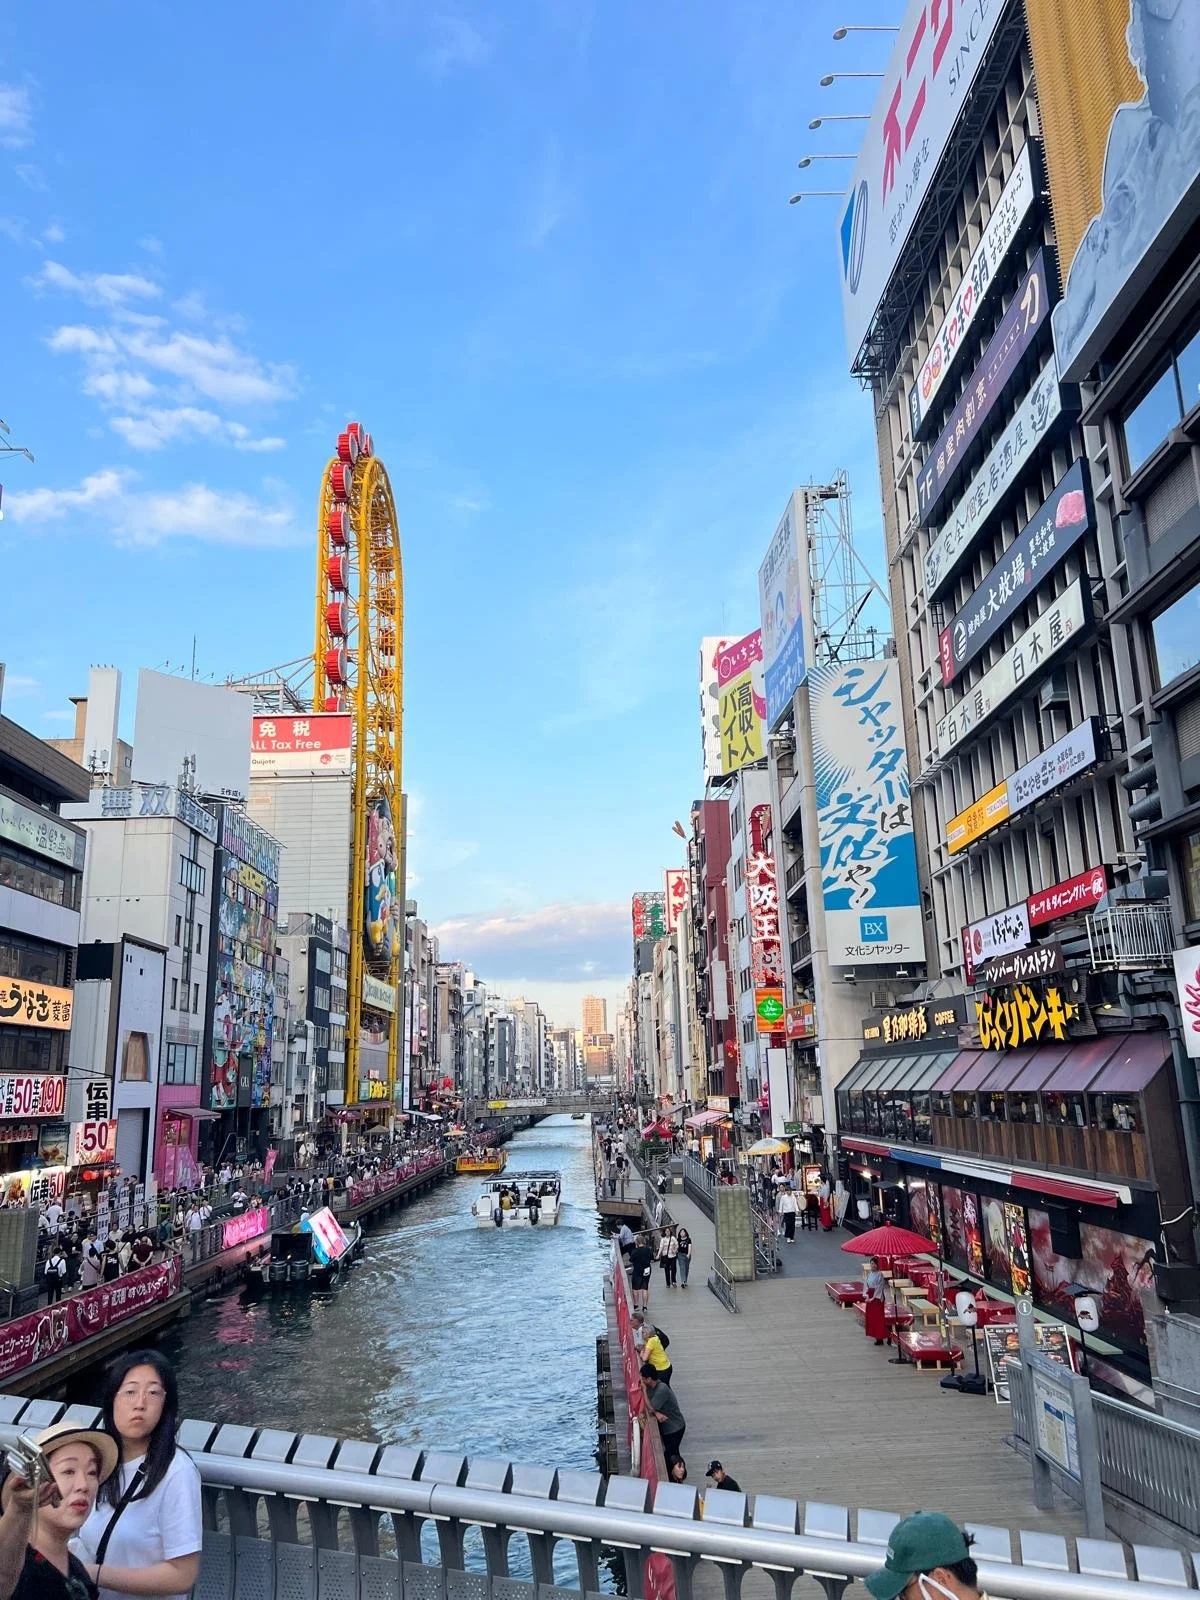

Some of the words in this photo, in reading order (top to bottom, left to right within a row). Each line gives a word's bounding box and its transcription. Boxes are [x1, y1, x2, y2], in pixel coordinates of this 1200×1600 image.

[988, 164, 1024, 248] しゃぶしゃぶ
[919, 477, 933, 509] 7F
[944, 420, 1028, 562] 完全個室居酒屋
[987, 553, 1025, 621] 大牧場
[942, 636, 951, 679] 5F
[1012, 609, 1063, 685] 白木屋
[259, 721, 310, 737] 免税
[723, 688, 739, 768] バイト
[737, 681, 754, 761] 高収入
[938, 721, 946, 740] 4F
[948, 692, 985, 746] 白木屋
[271, 740, 292, 750] Tax
[296, 739, 321, 749] Free
[865, 923, 884, 936] BX
[964, 936, 973, 976] 2F
[985, 949, 1056, 982] ハンバーグレストラン
[0, 982, 51, 1022] うなぎ
[934, 1009, 955, 1026] COFFEE
[975, 984, 1079, 1051] びっくりドンキー
[5, 1079, 15, 1114] 伝串
[13, 1078, 33, 1114] 50
[39, 1078, 63, 1113] 190
[86, 1082, 109, 1121] 伝串
[83, 1122, 109, 1151] 50
[31, 1177, 49, 1202] 伝串
[48, 1171, 64, 1199] 50
